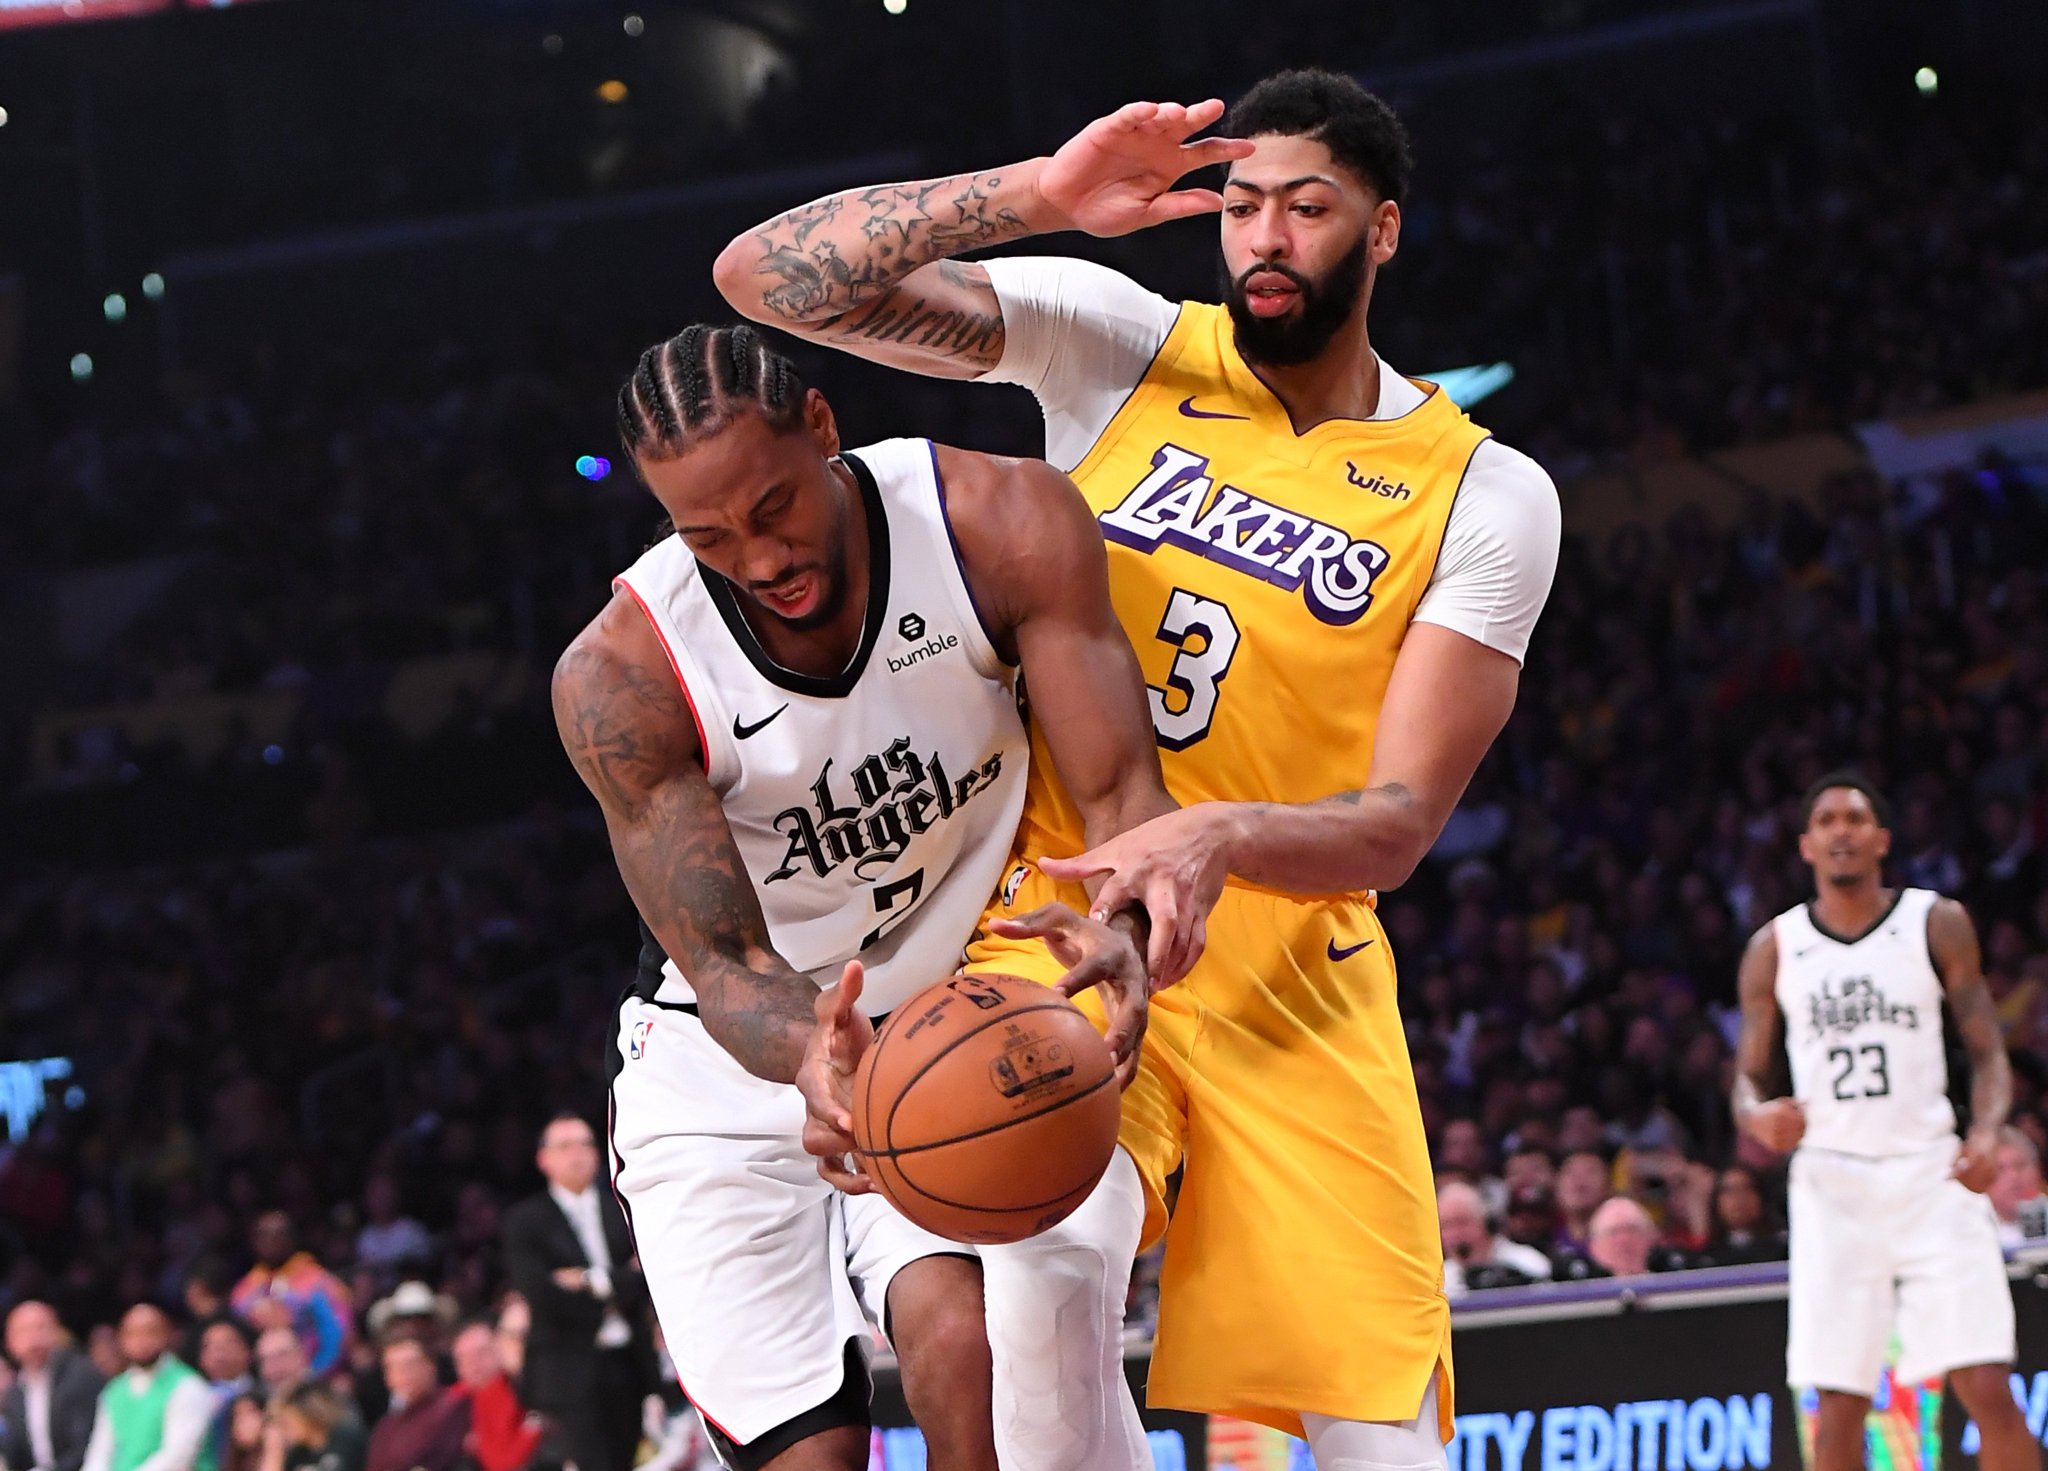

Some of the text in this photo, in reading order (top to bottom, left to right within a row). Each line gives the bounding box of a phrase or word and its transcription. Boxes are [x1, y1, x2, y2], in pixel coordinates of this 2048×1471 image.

[1346, 460, 1411, 501] wish
[1098, 442, 1391, 626] LAKERS
[886, 634, 958, 673] bumble
[1146, 586, 1241, 752] 3
[764, 750, 1004, 885] Angeles
[809, 736, 927, 826] Los
[1828, 1045, 1889, 1100] 23
[1445, 1392, 1773, 1471] ITY EDITION
